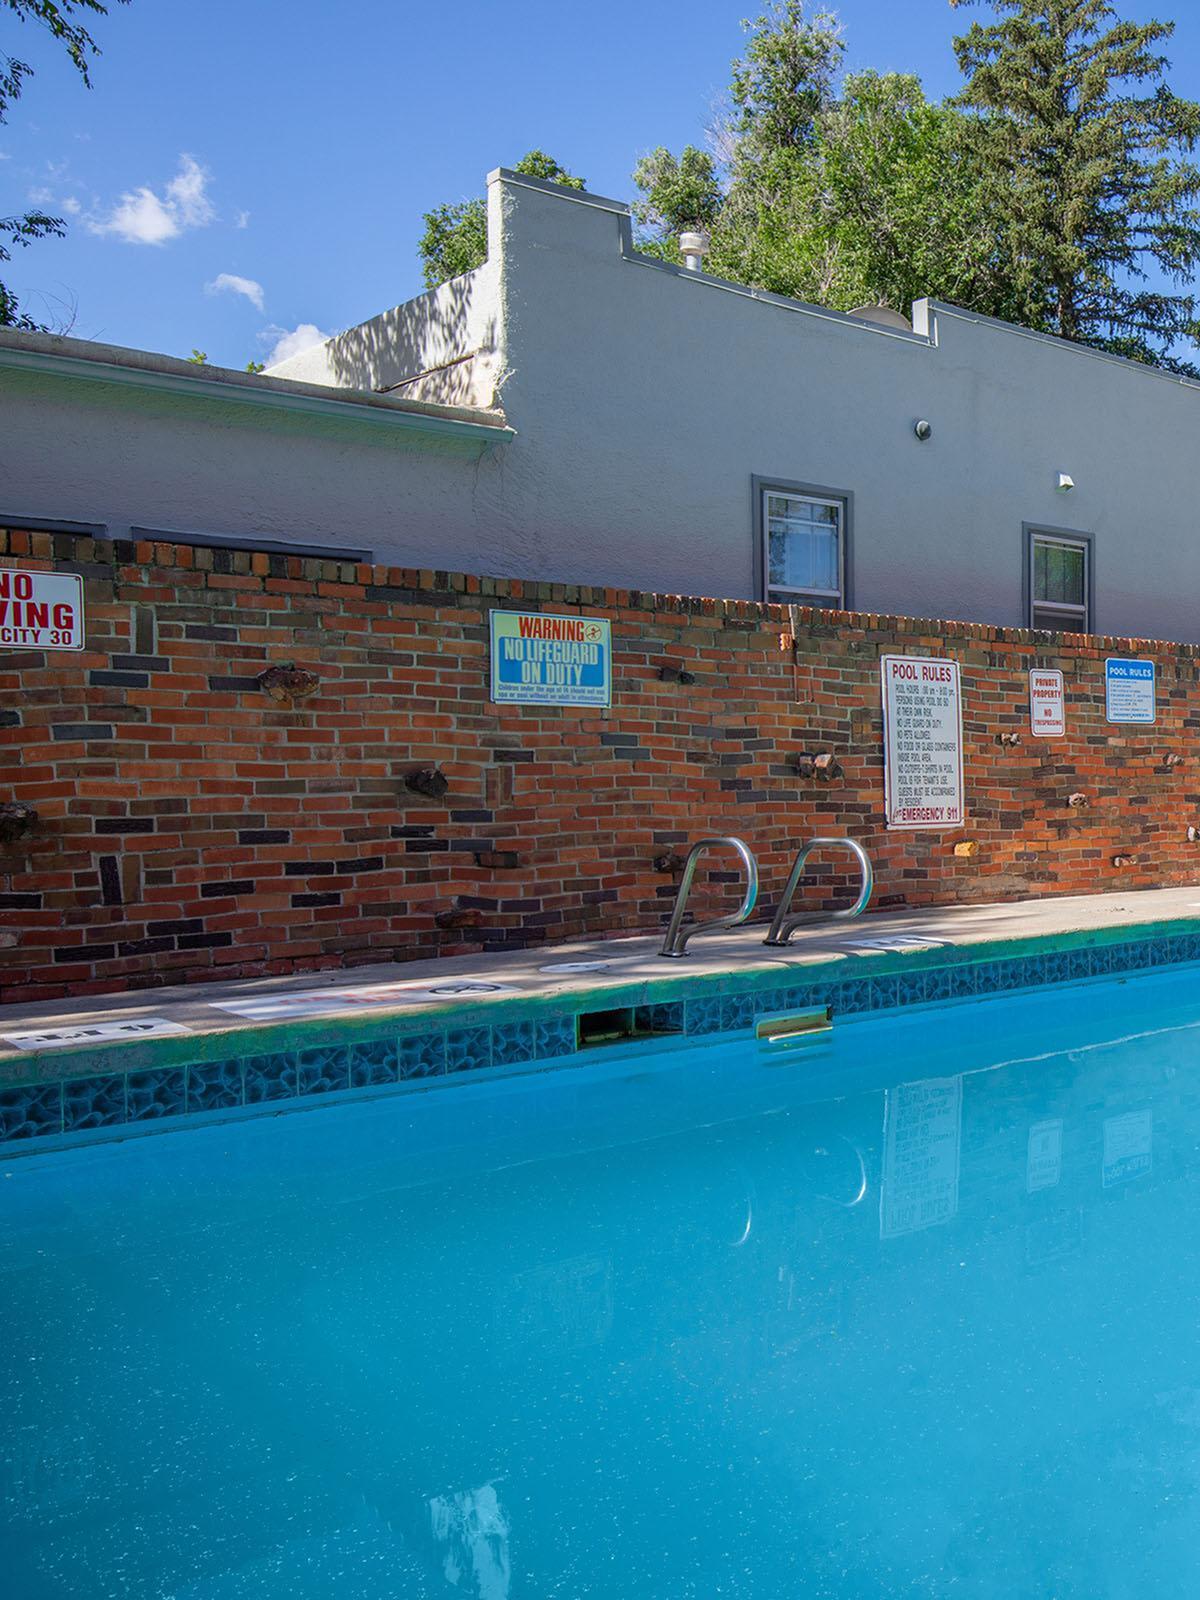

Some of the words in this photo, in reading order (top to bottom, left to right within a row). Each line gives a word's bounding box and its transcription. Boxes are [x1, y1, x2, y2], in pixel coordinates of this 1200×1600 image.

[1, 628, 41, 644] CITY
[50, 630, 72, 645] 30
[519, 616, 584, 642] WARNING
[504, 638, 524, 660] NO
[526, 640, 598, 665] LIFEGUARD
[522, 661, 540, 684] ON
[546, 663, 583, 686] DUTY
[892, 664, 918, 680] POOL
[922, 666, 952, 682] RULES
[1109, 667, 1127, 676] POOL
[1130, 668, 1152, 677] RULES
[1036, 678, 1058, 688] PRIVATE
[1033, 689, 1061, 698] PROPERTY
[1044, 708, 1052, 717] NO
[902, 808, 944, 820] EMERGENCY
[946, 807, 958, 820] 911
